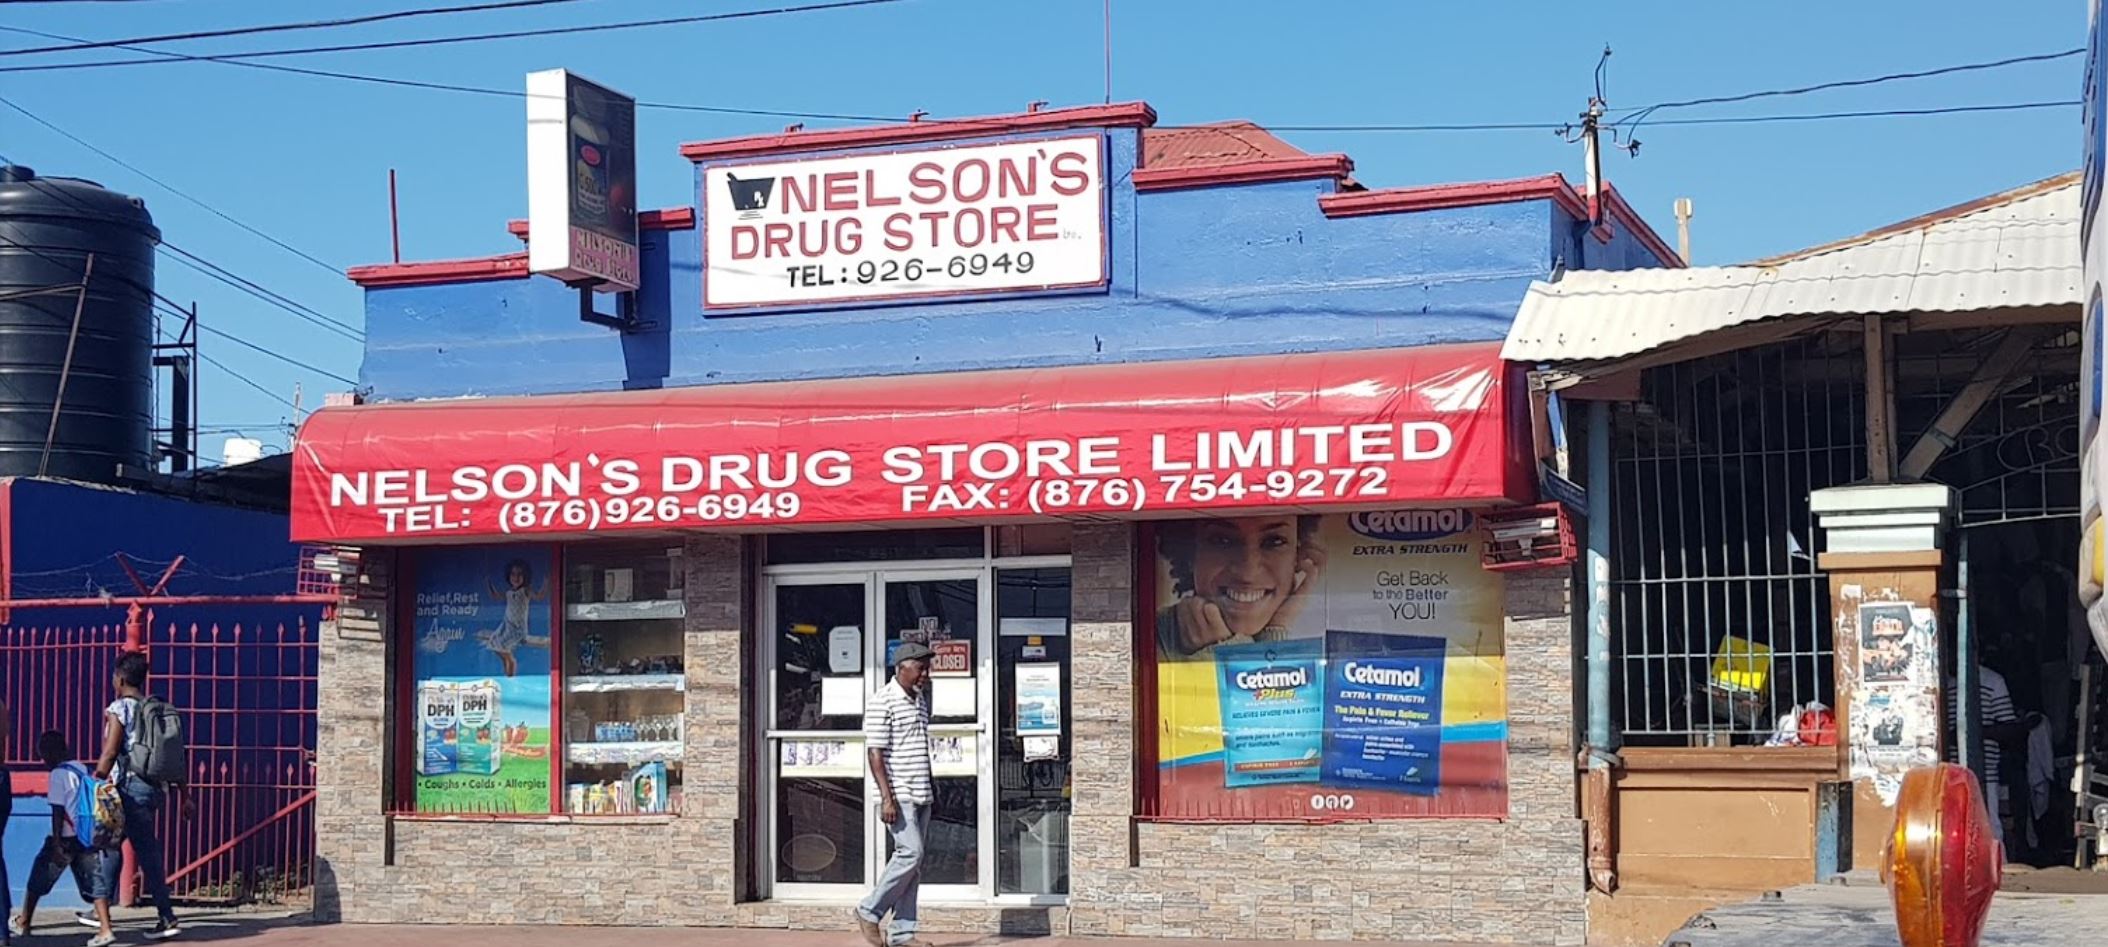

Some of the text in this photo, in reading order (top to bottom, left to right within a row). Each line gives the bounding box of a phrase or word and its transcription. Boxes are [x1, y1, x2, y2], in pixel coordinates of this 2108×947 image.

[780, 149, 1090, 214] NELSON'S
[731, 204, 1059, 260] DRUG STORE
[856, 252, 1036, 283] 926-6949
[331, 420, 1454, 506] NELSON'S DRUG STORE LIMITED
[902, 467, 1388, 514] FAX: (876) 754-9272
[378, 506, 470, 533] TEL:
[1352, 543, 1468, 556] EXTRA STRENGTH
[1377, 570, 1449, 587] Get Back
[1373, 588, 1449, 601] to the Better
[416, 604, 480, 617] and Ready
[1388, 602, 1436, 620] YOU!
[932, 654, 966, 670] CLOSED
[1236, 667, 1307, 689] Cetamol
[1344, 661, 1420, 687] Cetamol
[462, 699, 487, 712] DPH
[1340, 690, 1426, 704] EXTRA STRENGTH
[427, 704, 454, 717] DPH
[424, 778, 547, 791] Coughs Colds Allergies
